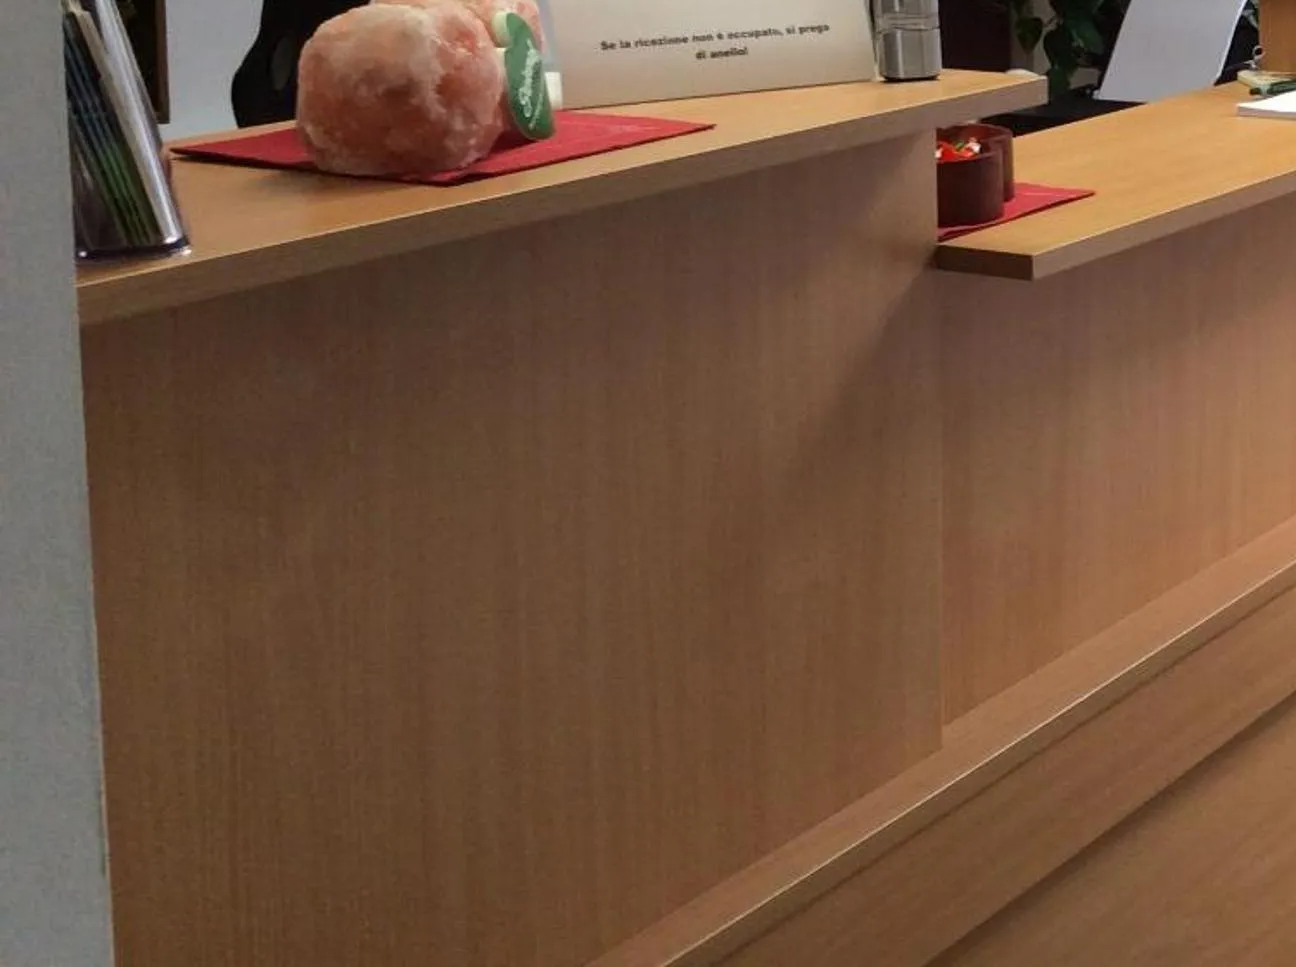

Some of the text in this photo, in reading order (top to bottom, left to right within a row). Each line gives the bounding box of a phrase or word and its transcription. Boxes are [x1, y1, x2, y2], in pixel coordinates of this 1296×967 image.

[600, 40, 616, 50] Se
[619, 40, 632, 48] la
[692, 33, 714, 42] non
[785, 26, 796, 35] si
[695, 50, 706, 60] di
